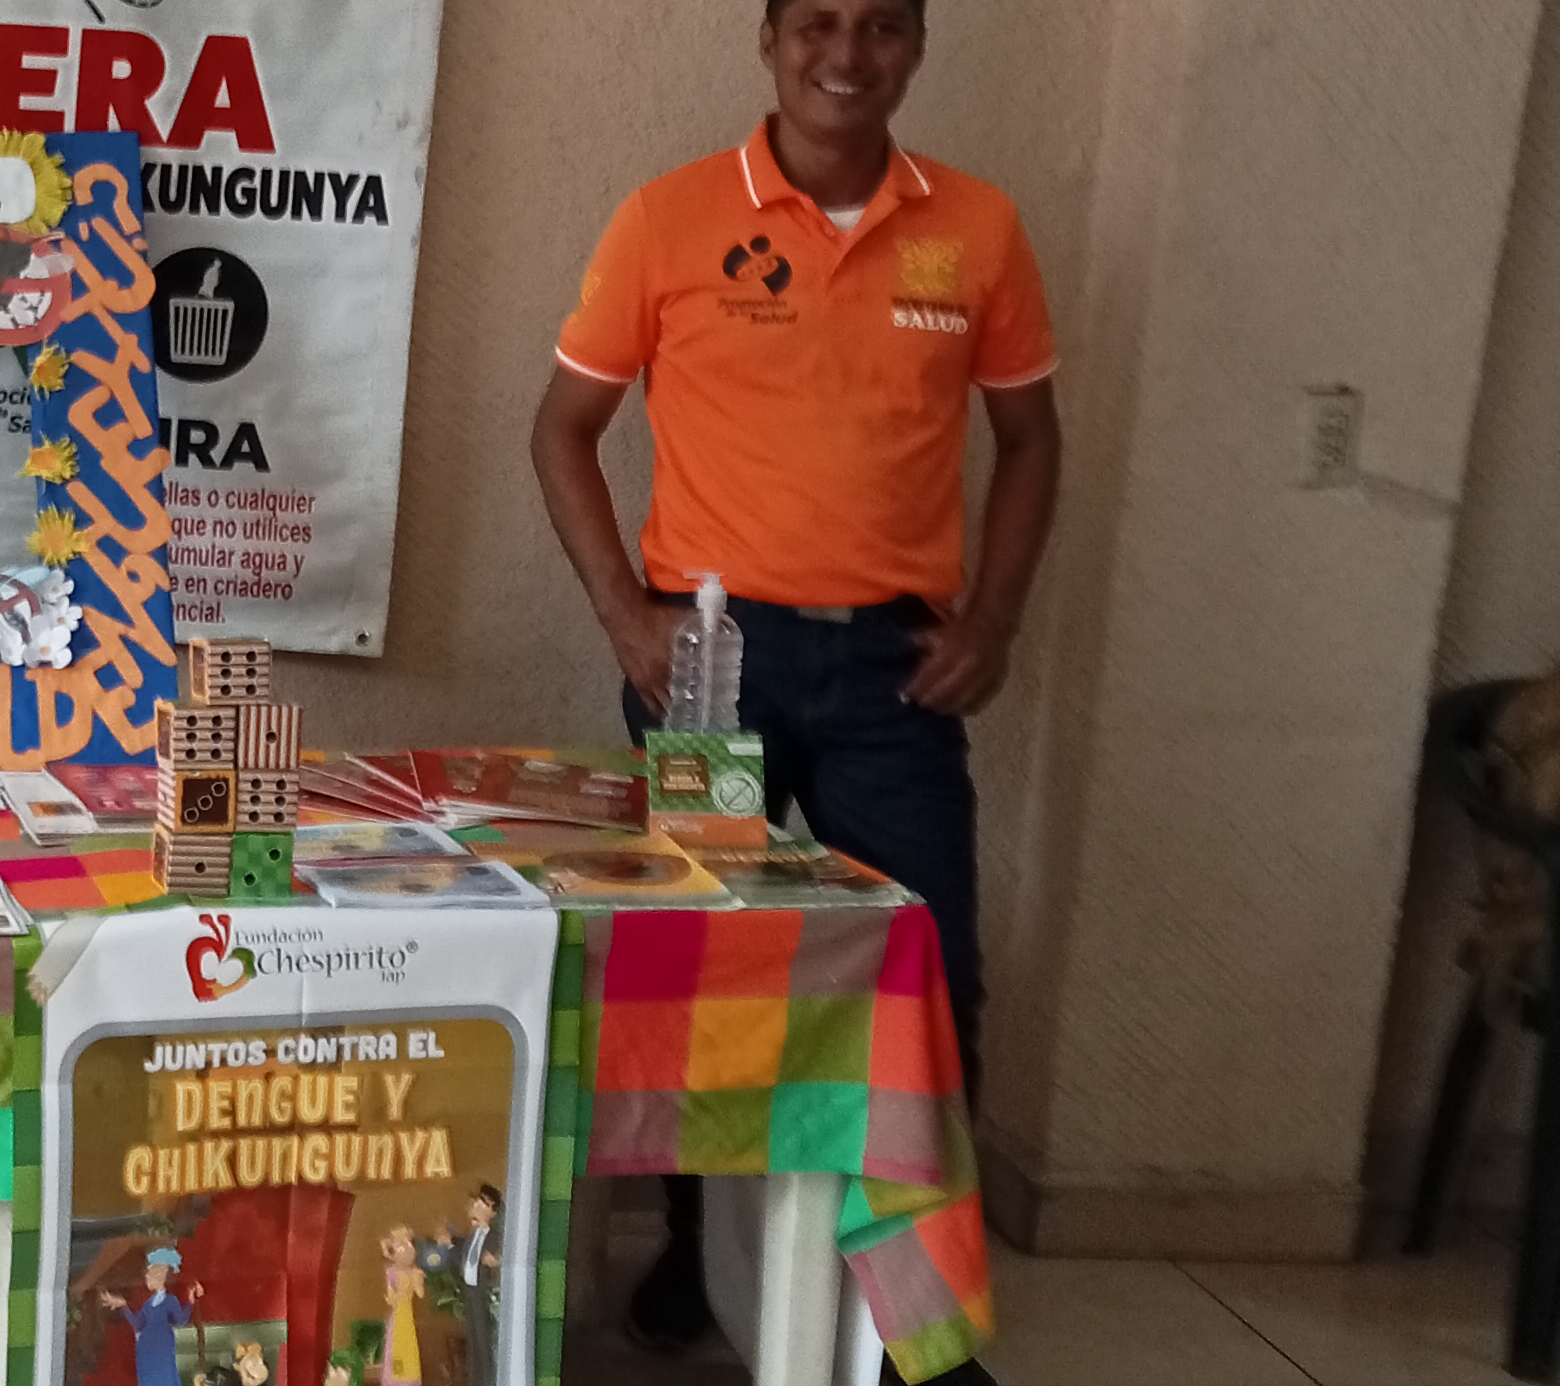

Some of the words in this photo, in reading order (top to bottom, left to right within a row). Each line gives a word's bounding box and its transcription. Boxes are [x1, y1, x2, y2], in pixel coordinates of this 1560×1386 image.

[140, 162, 389, 225] KUNGUNYA
[891, 307, 968, 335] SALUD
[159, 418, 271, 473] IRA
[207, 490, 219, 508] o
[225, 488, 316, 517] cualquier
[170, 517, 207, 541] que
[212, 519, 237, 539] no
[243, 517, 312, 544] utilices
[168, 544, 234, 568] umular
[240, 551, 287, 578] agua
[293, 554, 305, 579] y
[184, 576, 207, 594] en
[213, 574, 294, 601] criadero
[174, 601, 226, 623] ncial.
[235, 927, 324, 946] Fundación
[144, 1039, 266, 1073] JUNTOS
[277, 1032, 398, 1064] CONTRA
[407, 1031, 445, 1060] EL
[175, 1073, 361, 1132] DENGUE
[384, 1072, 414, 1121] Y
[124, 1126, 454, 1196] CHIKUNGUNYA
